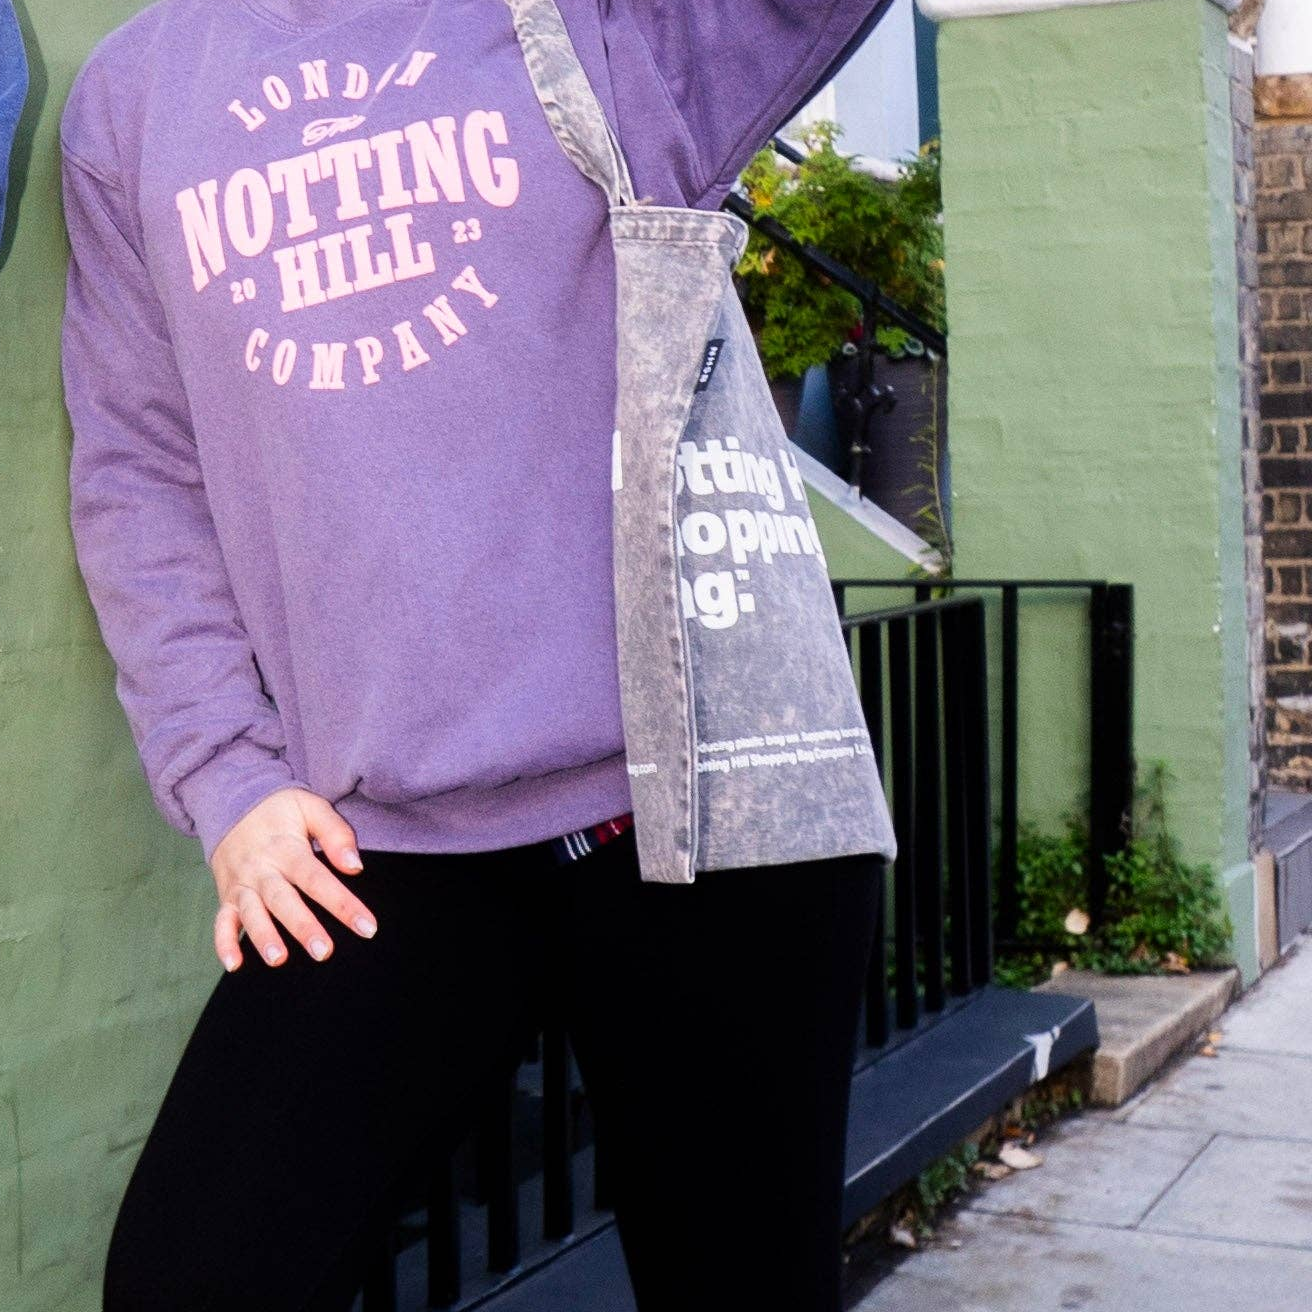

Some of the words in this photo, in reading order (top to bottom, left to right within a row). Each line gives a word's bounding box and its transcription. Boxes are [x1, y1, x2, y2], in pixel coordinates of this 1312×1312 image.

[176, 110, 520, 293] NOTTING
[452, 218, 482, 244] 23
[230, 278, 258, 304] 20
[273, 213, 435, 313] HILL
[244, 265, 499, 390] COMPANY
[676, 436, 785, 512] tting
